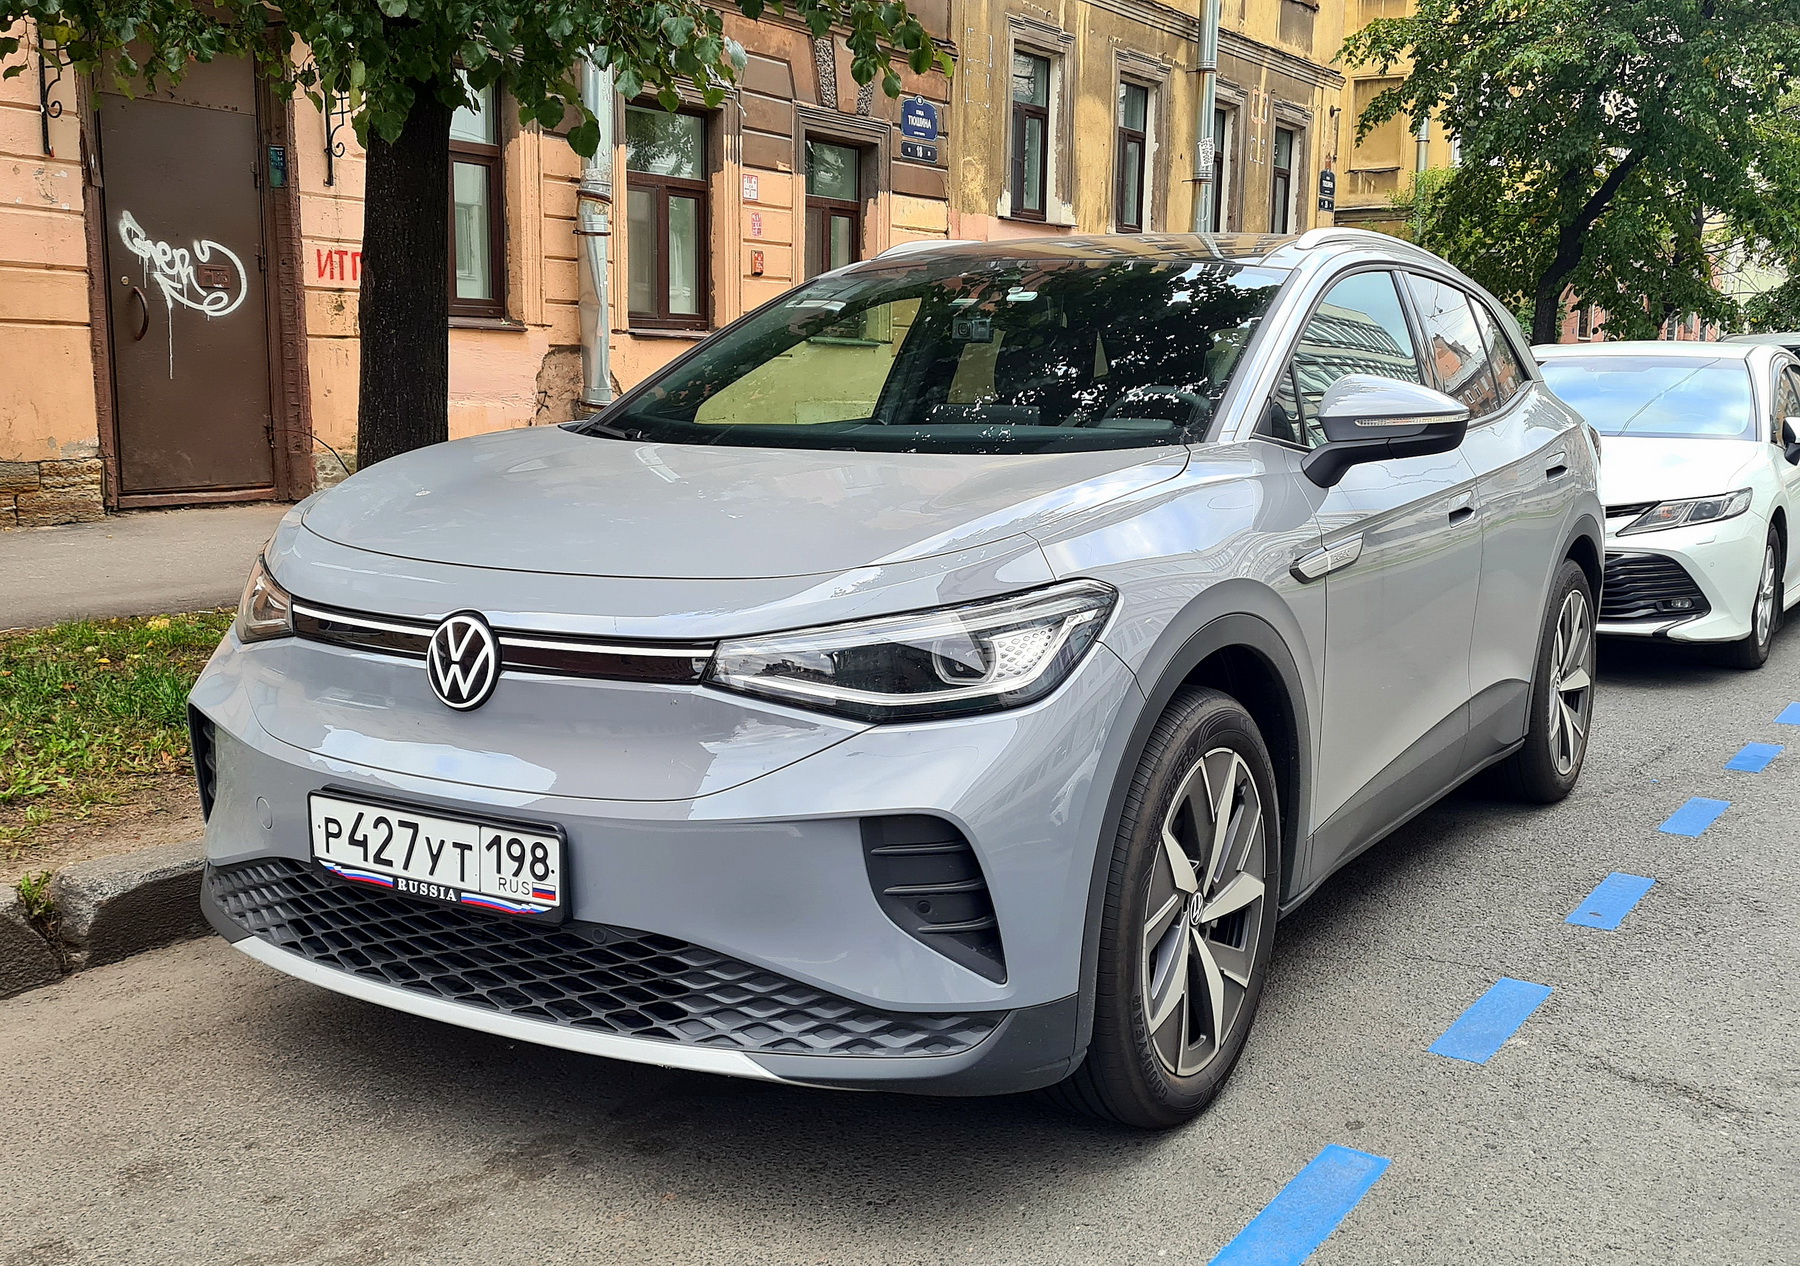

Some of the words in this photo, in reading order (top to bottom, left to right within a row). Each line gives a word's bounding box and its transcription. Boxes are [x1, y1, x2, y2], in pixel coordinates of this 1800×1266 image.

[908, 115, 932, 129] ТЮШИНА
[485, 834, 550, 882] 198
[396, 877, 457, 902] RUSSIA
[498, 877, 531, 896] RUS
